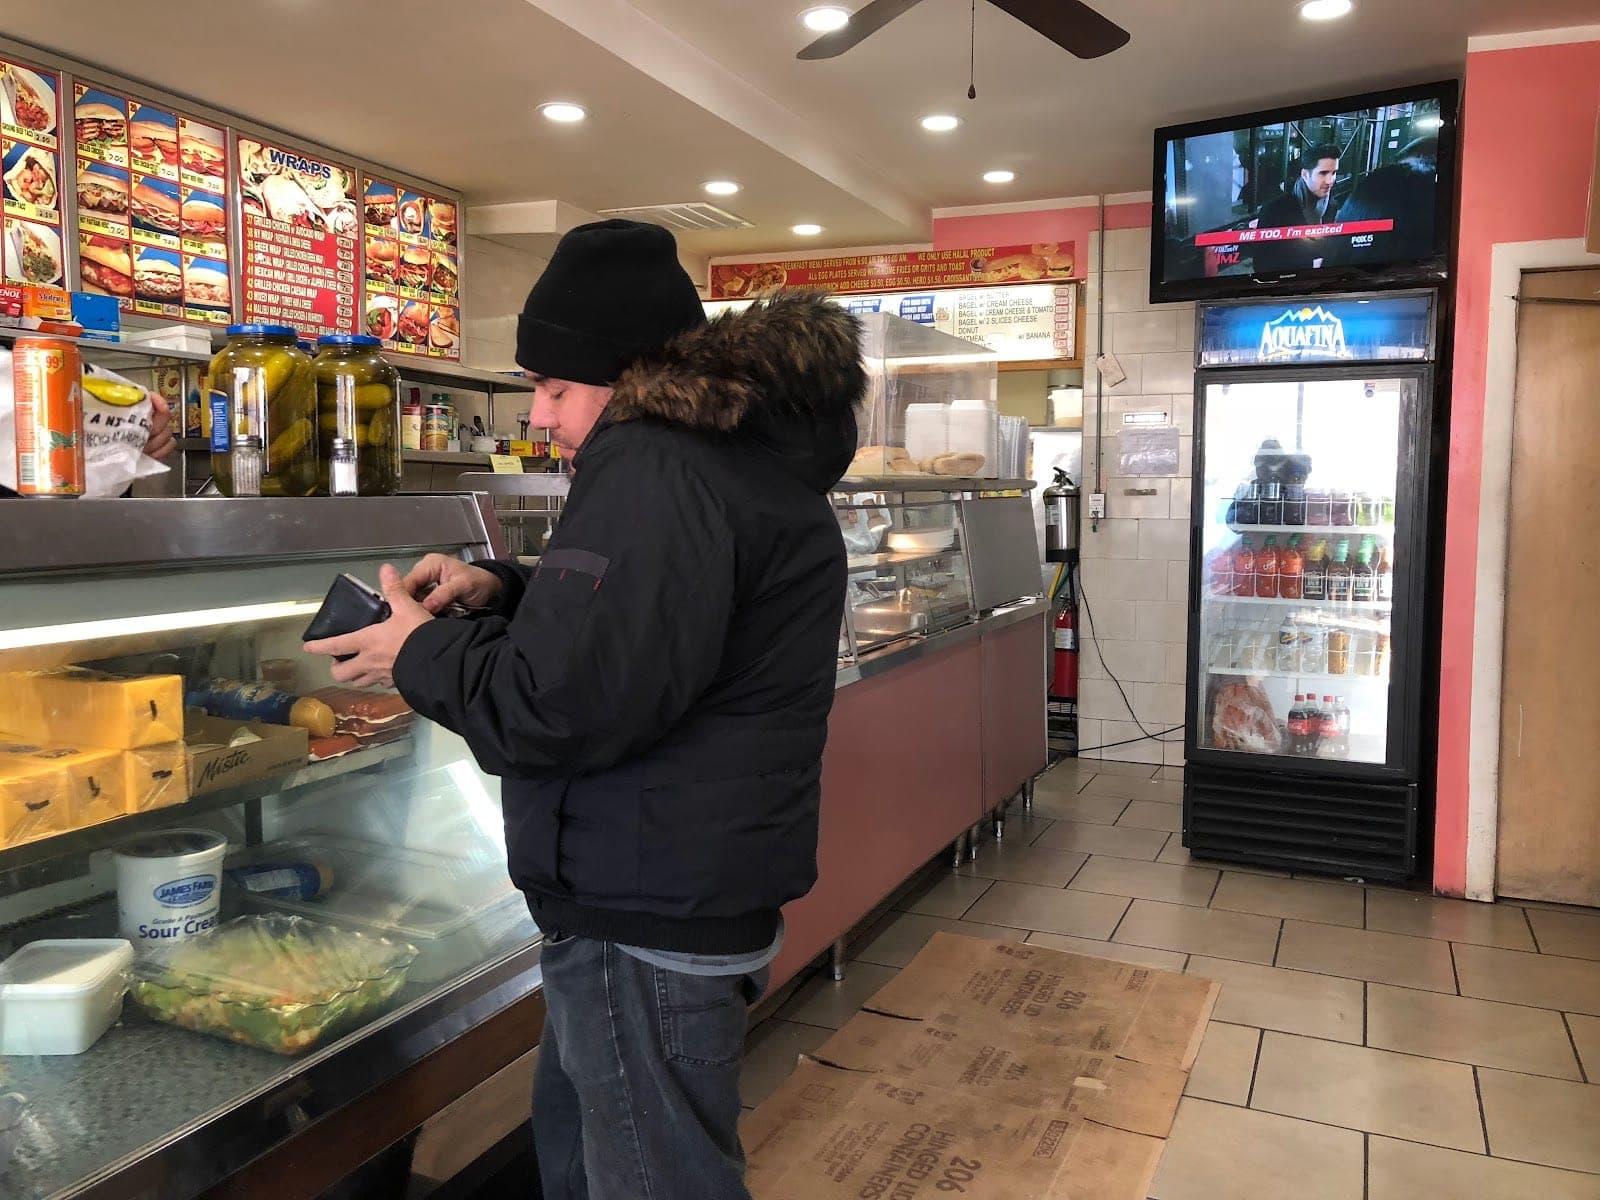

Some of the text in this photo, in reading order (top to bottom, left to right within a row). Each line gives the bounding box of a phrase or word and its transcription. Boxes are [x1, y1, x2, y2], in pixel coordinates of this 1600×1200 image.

[269, 149, 332, 179] WRAPS
[1239, 223, 1344, 242] ME TOO, I'm excited
[782, 261, 809, 271] BREAKFAST
[809, 259, 823, 270] MENU
[823, 258, 843, 269] SERVED
[843, 257, 857, 267] FROM
[918, 247, 995, 261] WE ONLY USE HALAL PRODUCT
[808, 272, 818, 281] ALL
[818, 271, 829, 280] EGG
[829, 270, 847, 280] PLATES
[848, 268, 867, 278] SERVED
[896, 265, 911, 275] FRIES
[911, 264, 920, 273] OR
[920, 263, 936, 272] GRITS
[936, 262, 948, 272] AND
[949, 261, 966, 271] TOAST
[813, 281, 839, 292] SANDWICH
[840, 281, 850, 290] ADD
[850, 279, 870, 289] CHEESE
[885, 278, 897, 287] EGG
[912, 276, 927, 285] HERO
[943, 272, 973, 283] CROISSANT
[958, 301, 978, 310] BAGEL
[986, 299, 1009, 308] CREAM
[1008, 297, 1033, 306] CHEESE
[958, 310, 978, 318] BAGEL
[985, 308, 1005, 317] CREAM
[1004, 306, 1027, 316] CHEESE
[1032, 305, 1054, 314] TOMATO
[958, 318, 978, 327] BAGEL
[991, 316, 1013, 325] SLICES
[1013, 314, 1039, 324] CHEESE
[958, 326, 979, 335] DONUT
[1025, 331, 1051, 340] BANANA
[1258, 318, 1346, 359] AQUAFINA
[197, 749, 253, 788] Mistic
[159, 883, 192, 899] JAMES
[138, 916, 219, 940] Sour Crea
[1000, 969, 1044, 1015] CONTAINERS
[1057, 989, 1088, 1011] 206
[858, 1123, 931, 1200] CONTAINERS
[906, 1130, 956, 1180] HINGED
[935, 1155, 982, 1193] 206
